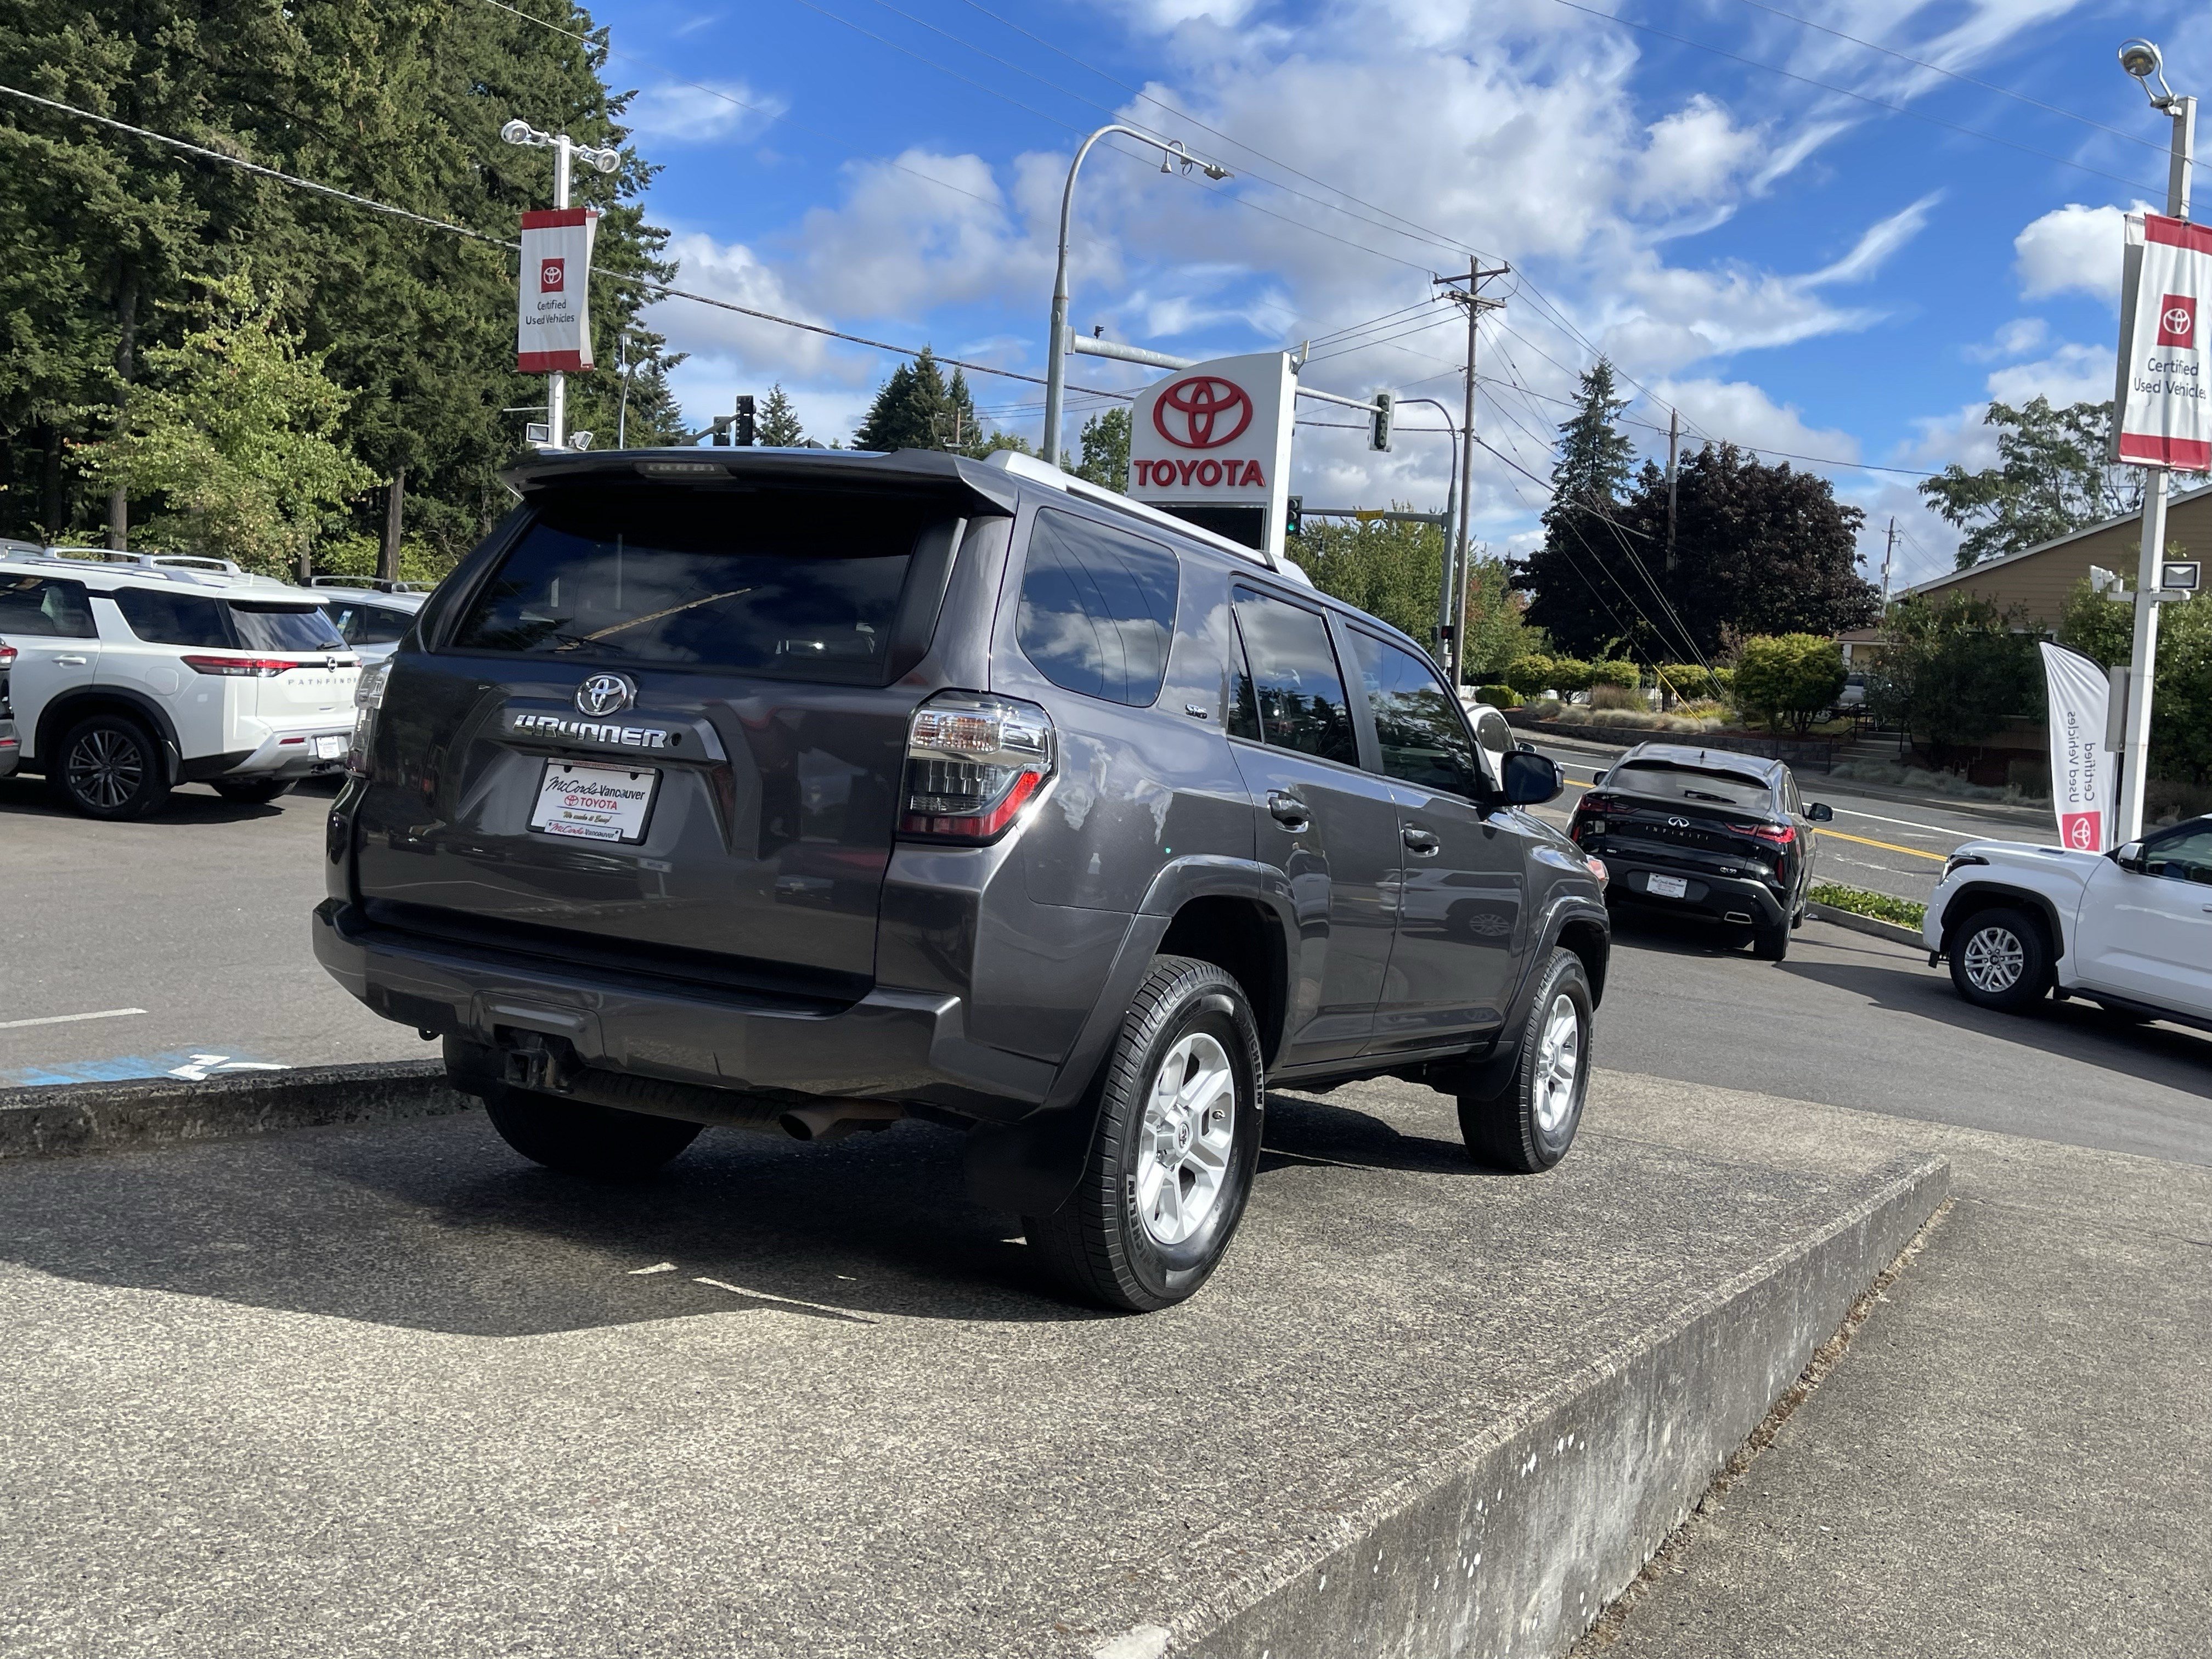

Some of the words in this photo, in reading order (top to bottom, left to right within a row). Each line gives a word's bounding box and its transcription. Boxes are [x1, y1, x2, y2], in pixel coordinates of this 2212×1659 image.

[538, 299, 566, 311] Certified
[526, 315, 545, 325] Used
[546, 313, 574, 324] Vehicles
[2148, 358, 2199, 376] Certified
[2134, 377, 2161, 393] Used
[2165, 381, 2206, 399] Vehicles
[1133, 459, 1266, 487] TOYOTA
[513, 714, 667, 748] 4RUNNER
[580, 797, 617, 810] TOYOTA
